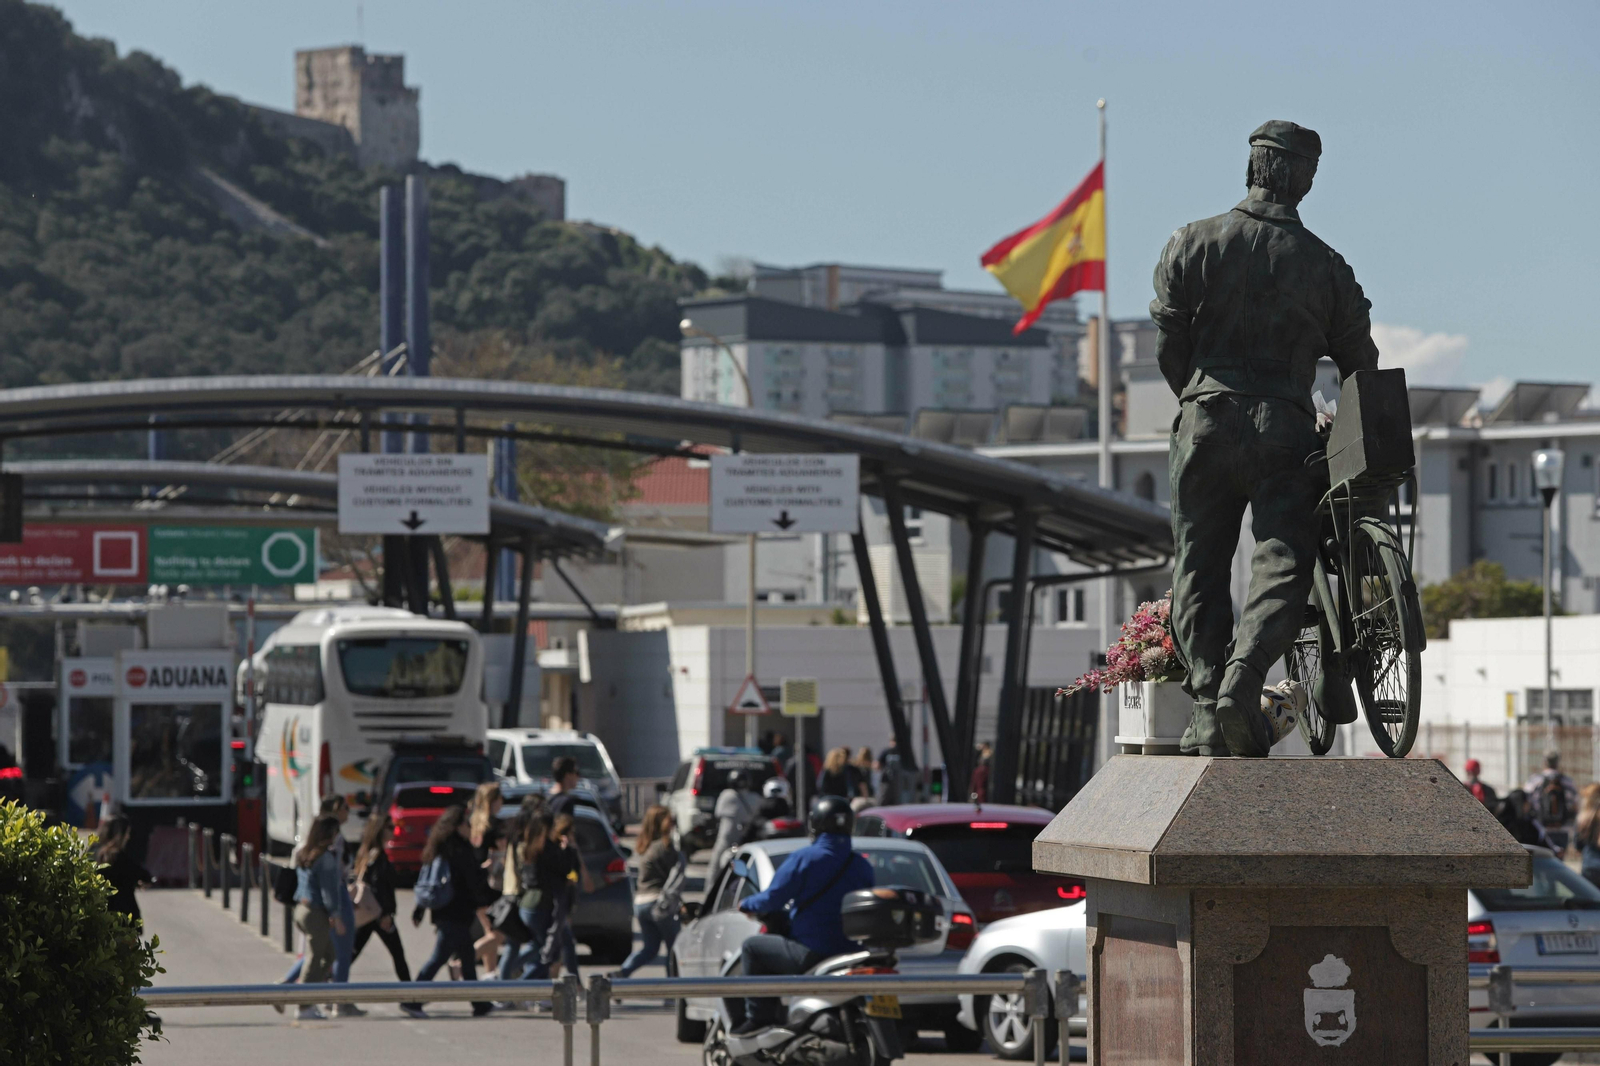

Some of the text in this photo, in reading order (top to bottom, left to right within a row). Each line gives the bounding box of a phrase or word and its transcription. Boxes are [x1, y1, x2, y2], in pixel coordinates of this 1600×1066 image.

[408, 467, 473, 477] ADUANEROS
[363, 485, 462, 494] VEHICLES WITHOUT
[744, 485, 821, 494] VEHICLES WITH
[352, 498, 473, 507] CUSTOMS FORMALITIES
[724, 498, 774, 507] CUSTOMS
[153, 555, 252, 568] Nothing to declare
[148, 665, 228, 688] ADUANA
